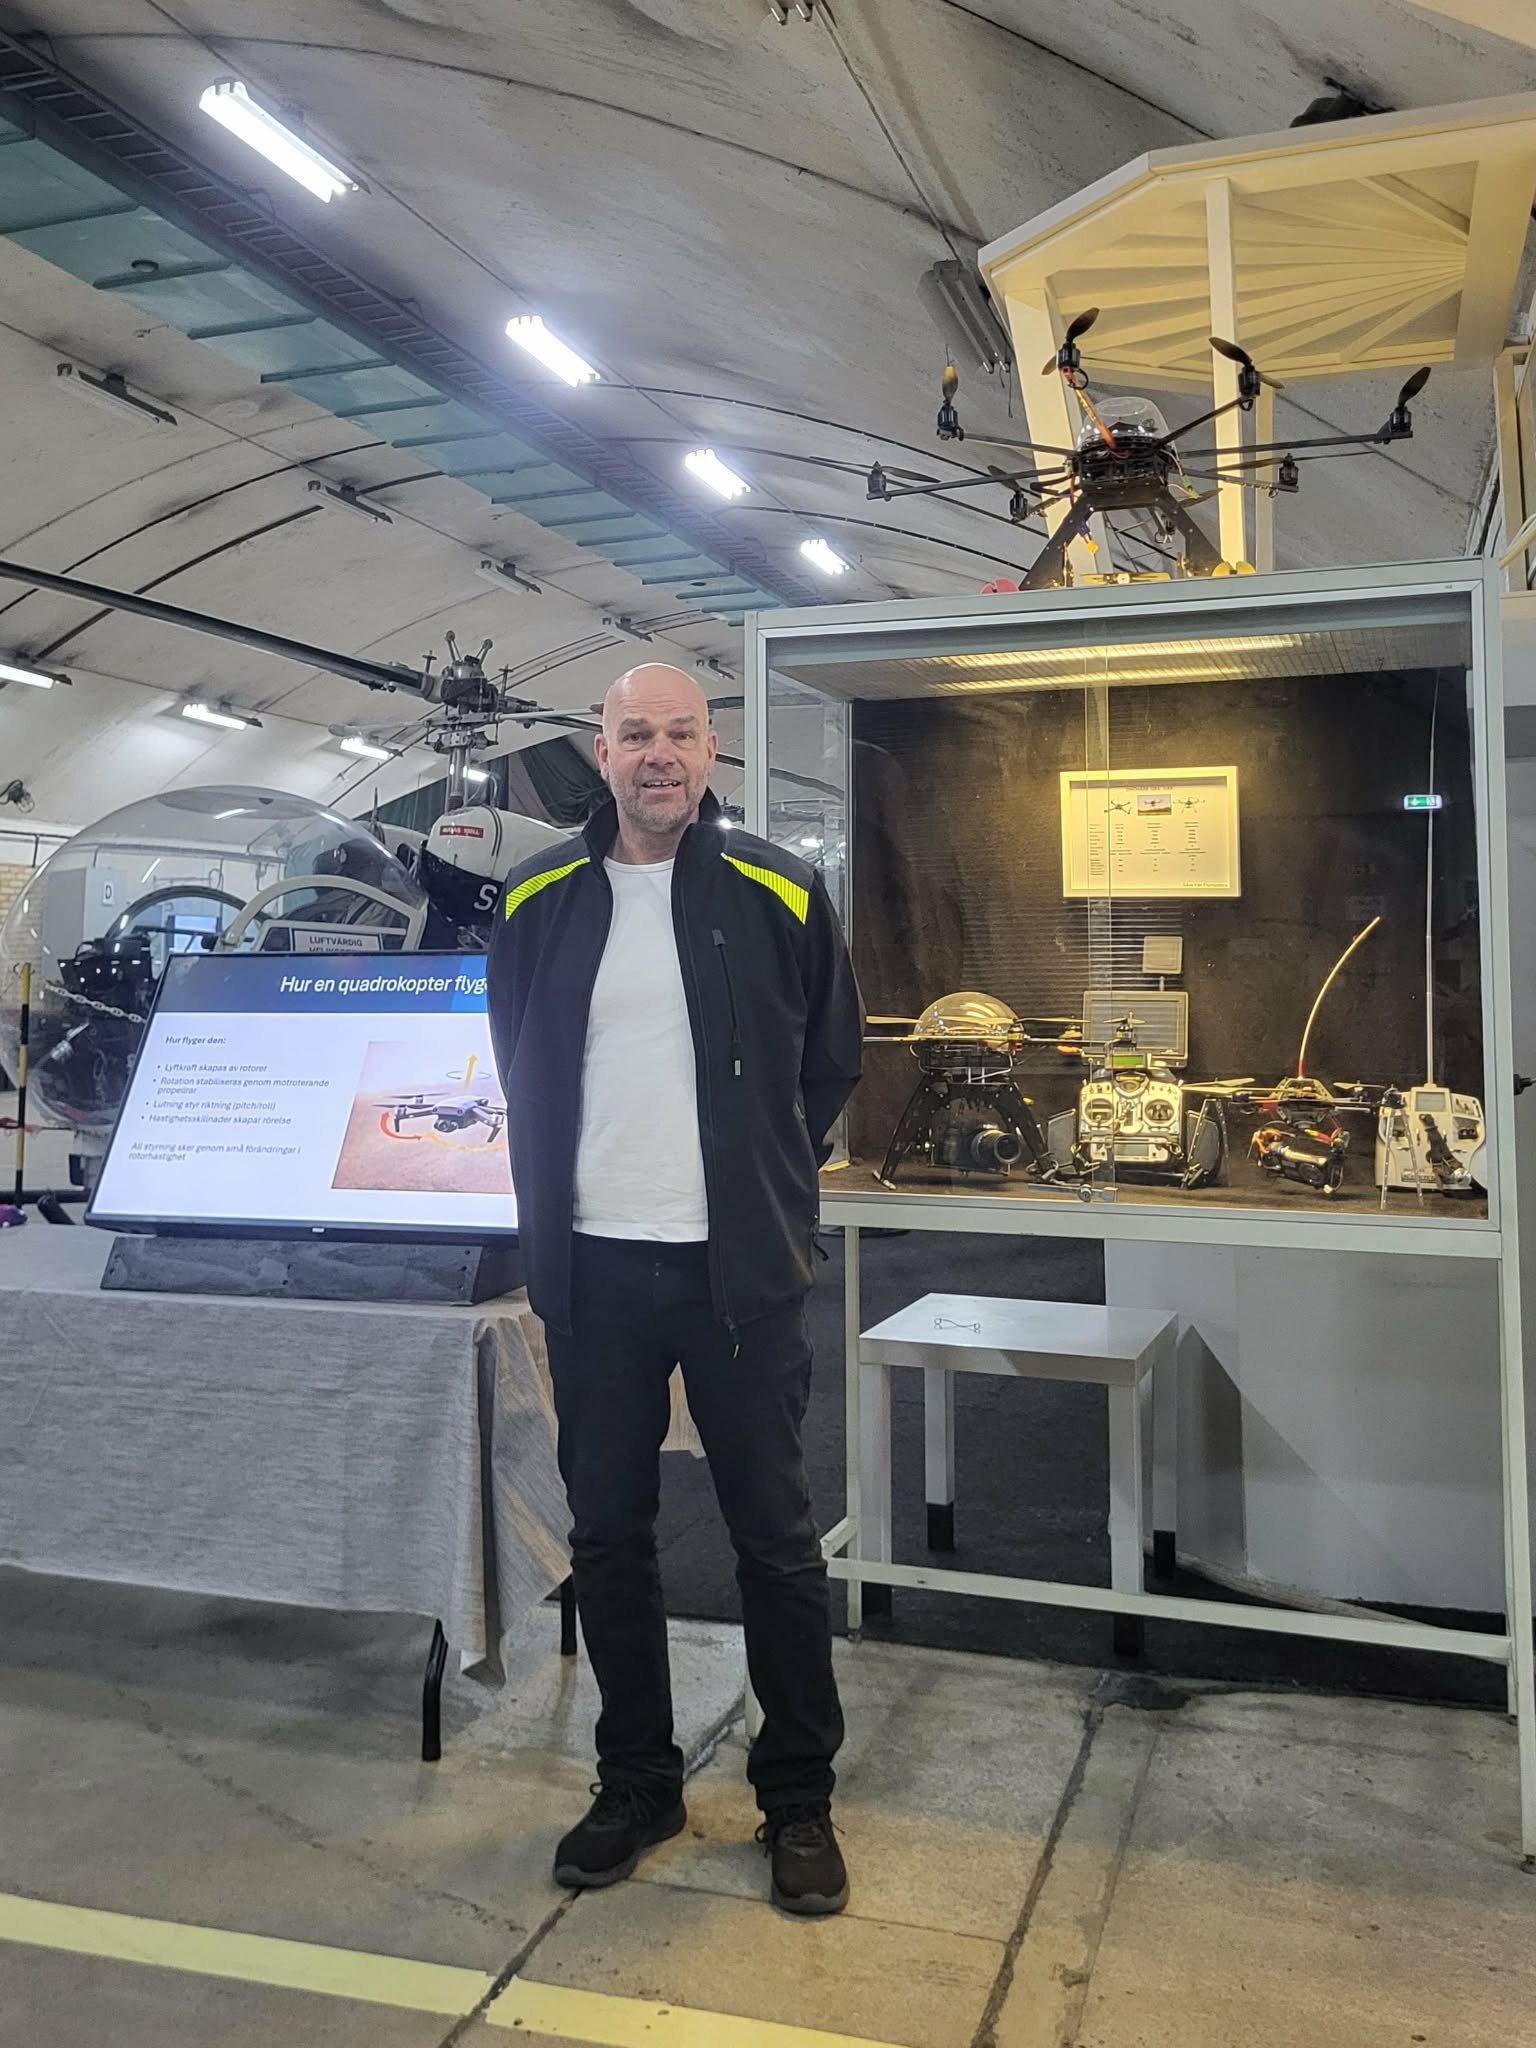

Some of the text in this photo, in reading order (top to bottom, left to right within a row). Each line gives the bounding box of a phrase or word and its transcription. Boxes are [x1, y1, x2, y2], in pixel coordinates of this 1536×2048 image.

[474, 884, 498, 914] S
[279, 975, 488, 995] Hur en quadrokopter flyg
[165, 1036, 226, 1045] Hur flyger den:
[164, 1063, 197, 1073] Lyftkraft
[198, 1063, 227, 1073] skapas
[239, 1064, 268, 1072] rotorer
[160, 1077, 195, 1085] Rotation
[243, 1079, 272, 1088] genom
[272, 1079, 330, 1088] motroterande
[153, 1100, 183, 1110] Lutning
[184, 1101, 199, 1110] styr
[200, 1101, 231, 1111] riktning
[233, 1115, 262, 1125] skapar
[177, 1143, 195, 1151] sker
[195, 1145, 225, 1153] genom
[226, 1143, 244, 1152] små
